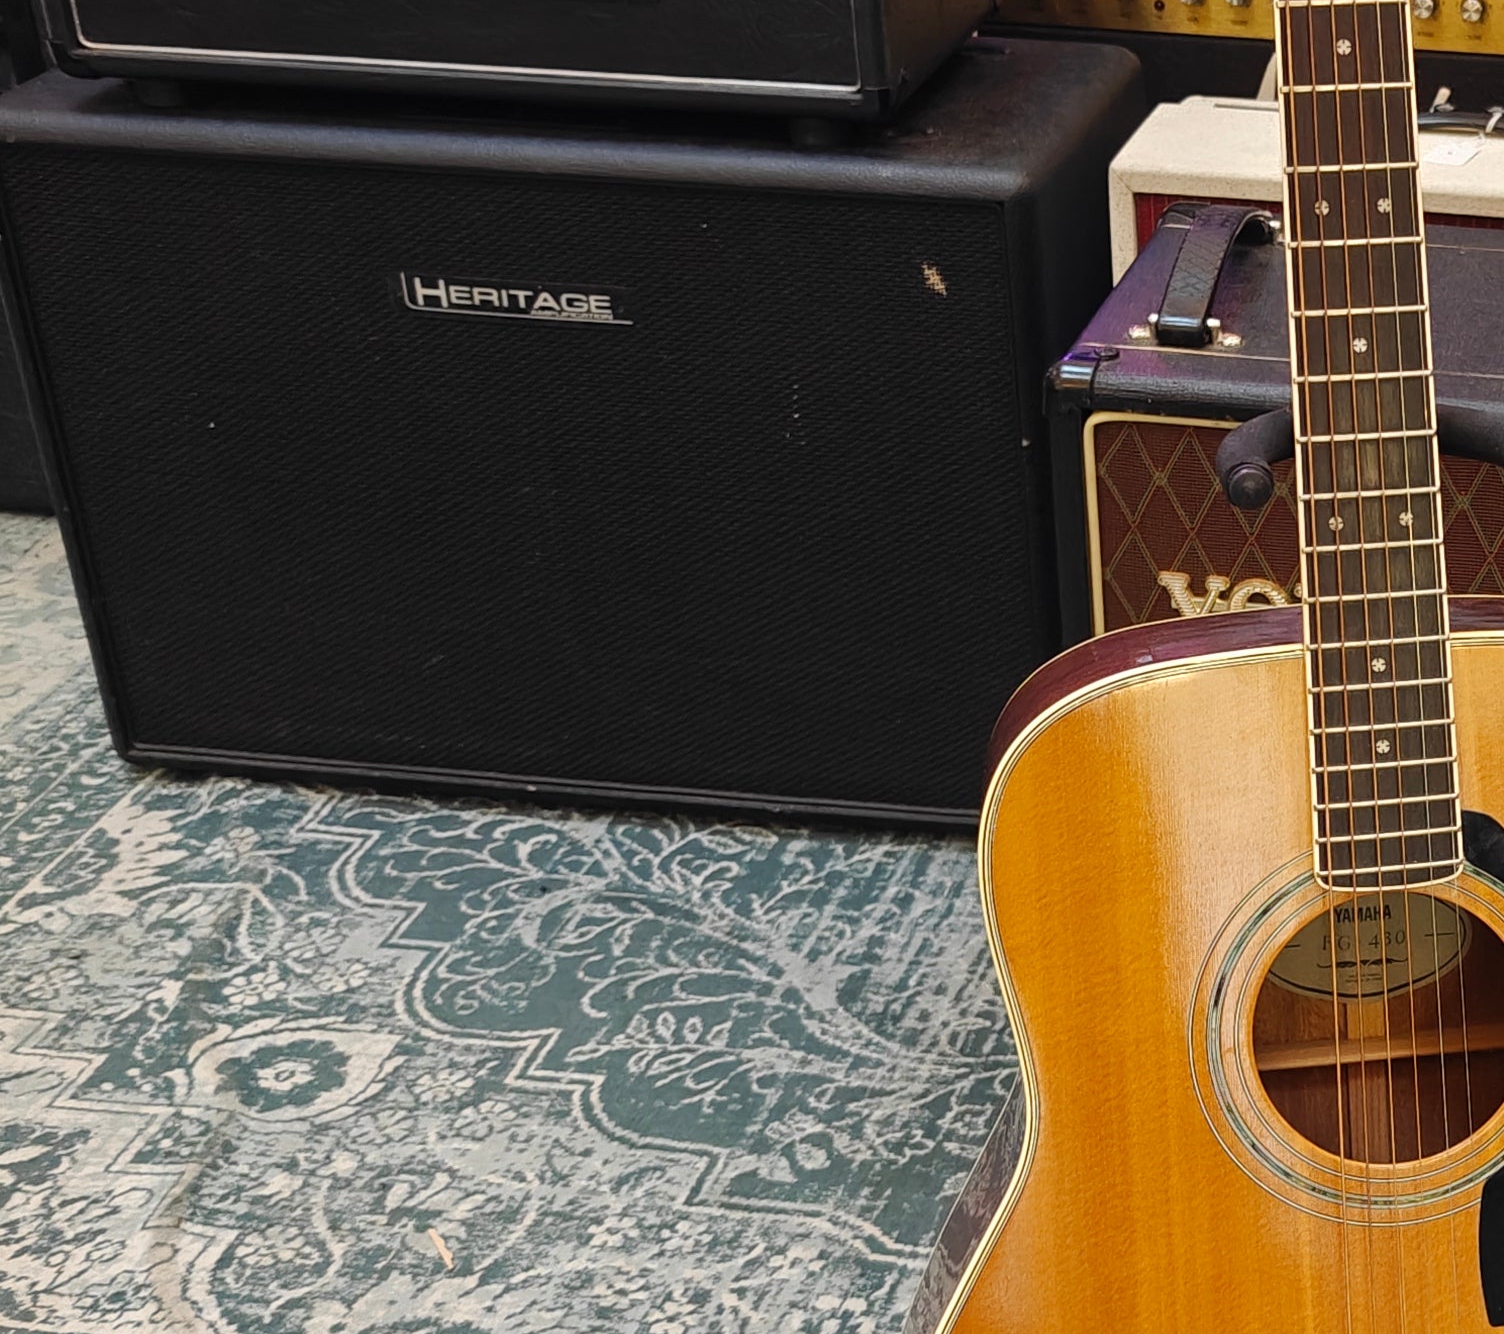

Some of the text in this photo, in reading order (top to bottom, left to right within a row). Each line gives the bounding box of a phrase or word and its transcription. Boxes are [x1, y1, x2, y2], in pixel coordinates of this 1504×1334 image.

[413, 277, 612, 314] HERITAGE
[1157, 570, 1303, 617] VO
[1334, 904, 1392, 924] YAMAHA
